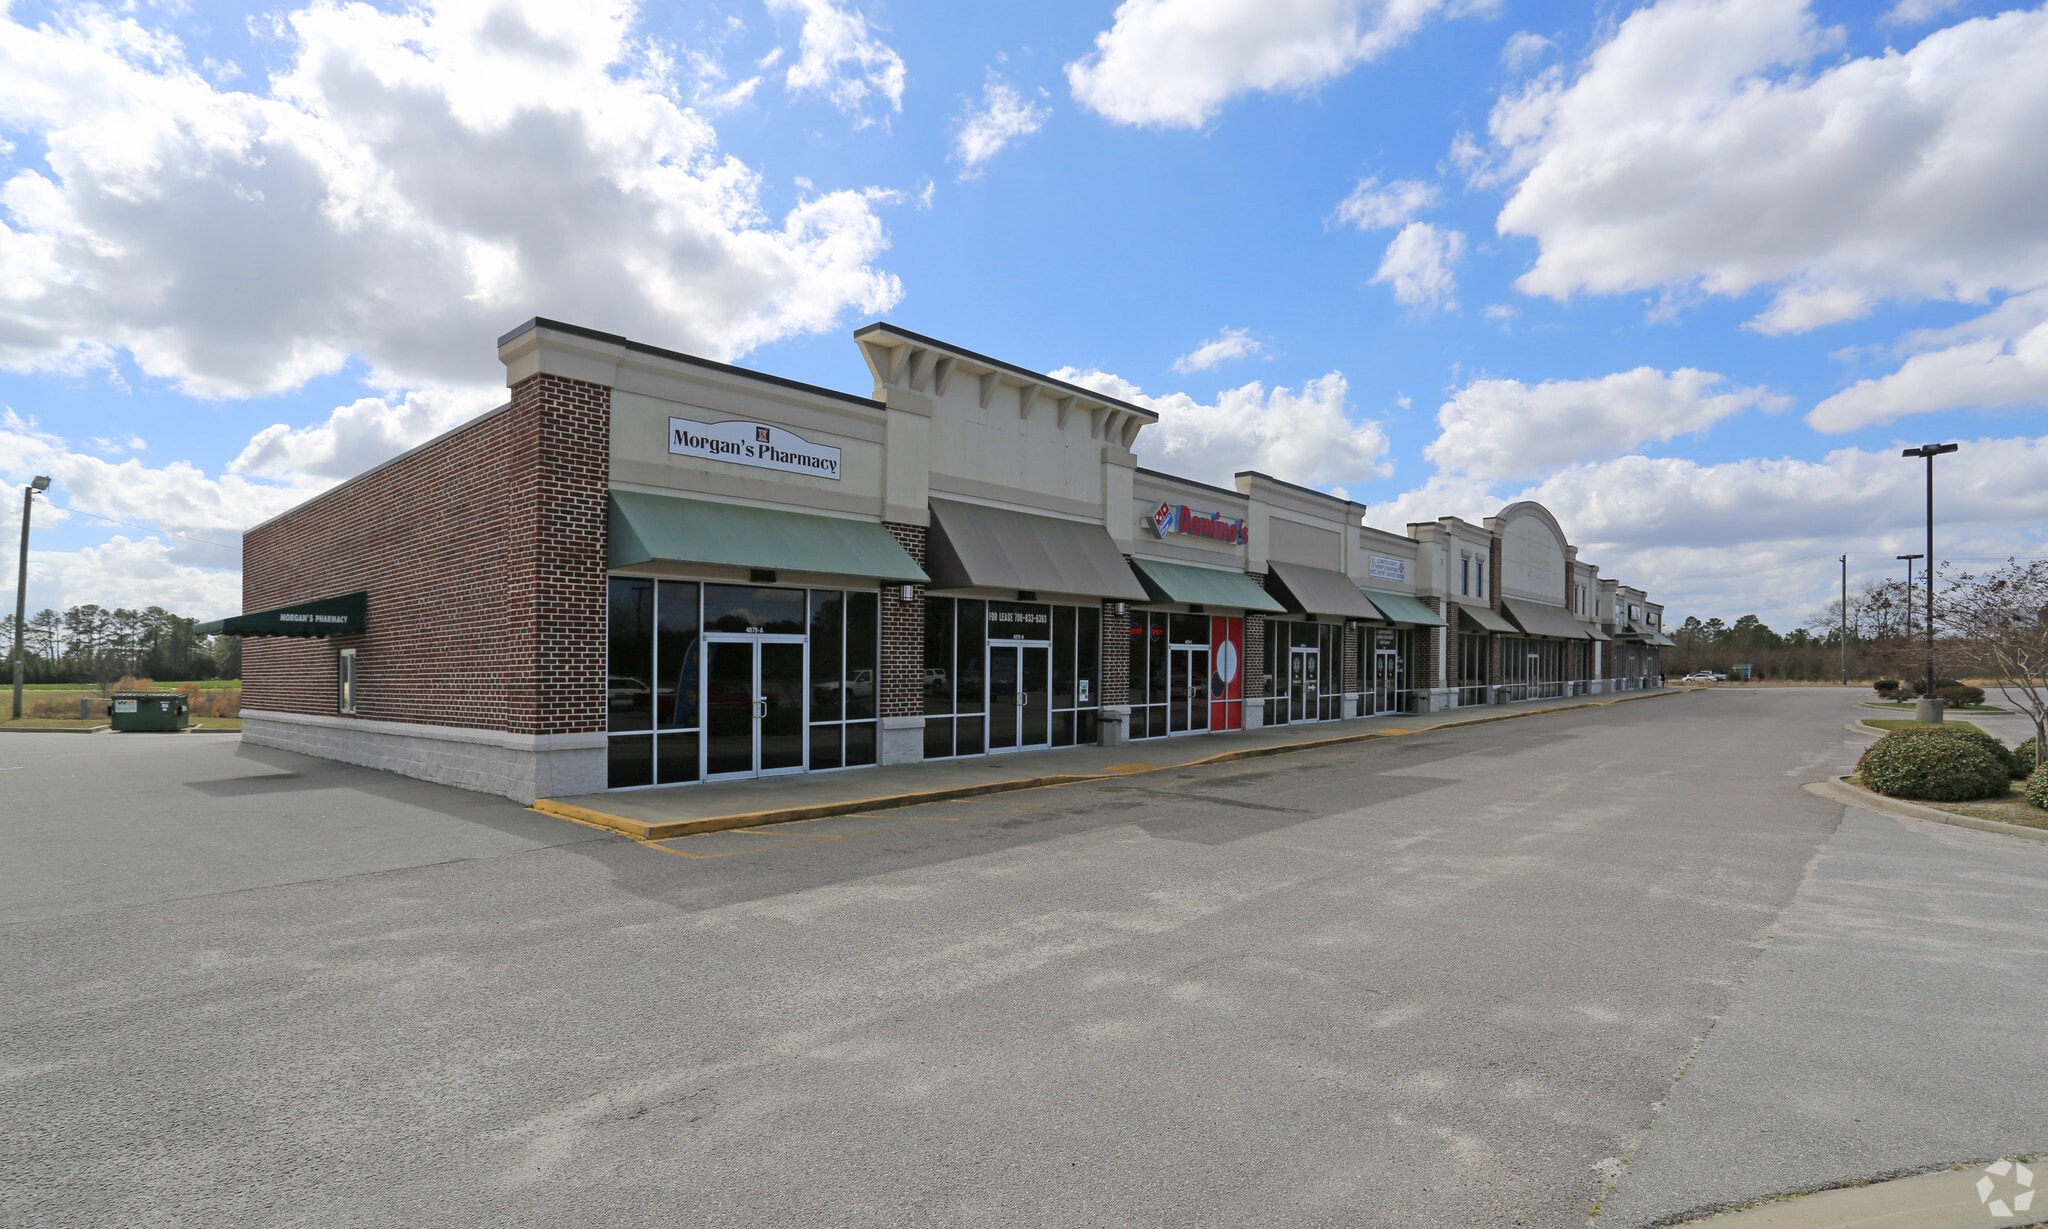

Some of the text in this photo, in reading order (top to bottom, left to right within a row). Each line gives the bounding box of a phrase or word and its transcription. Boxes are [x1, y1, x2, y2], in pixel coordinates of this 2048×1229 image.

[673, 429, 837, 474] Morgan's Pharmacy
[1177, 504, 1249, 545] Domino's
[280, 613, 348, 624] MORGAN'S PHARMACY
[988, 611, 998, 622] FOR
[999, 612, 1014, 622] LEASE
